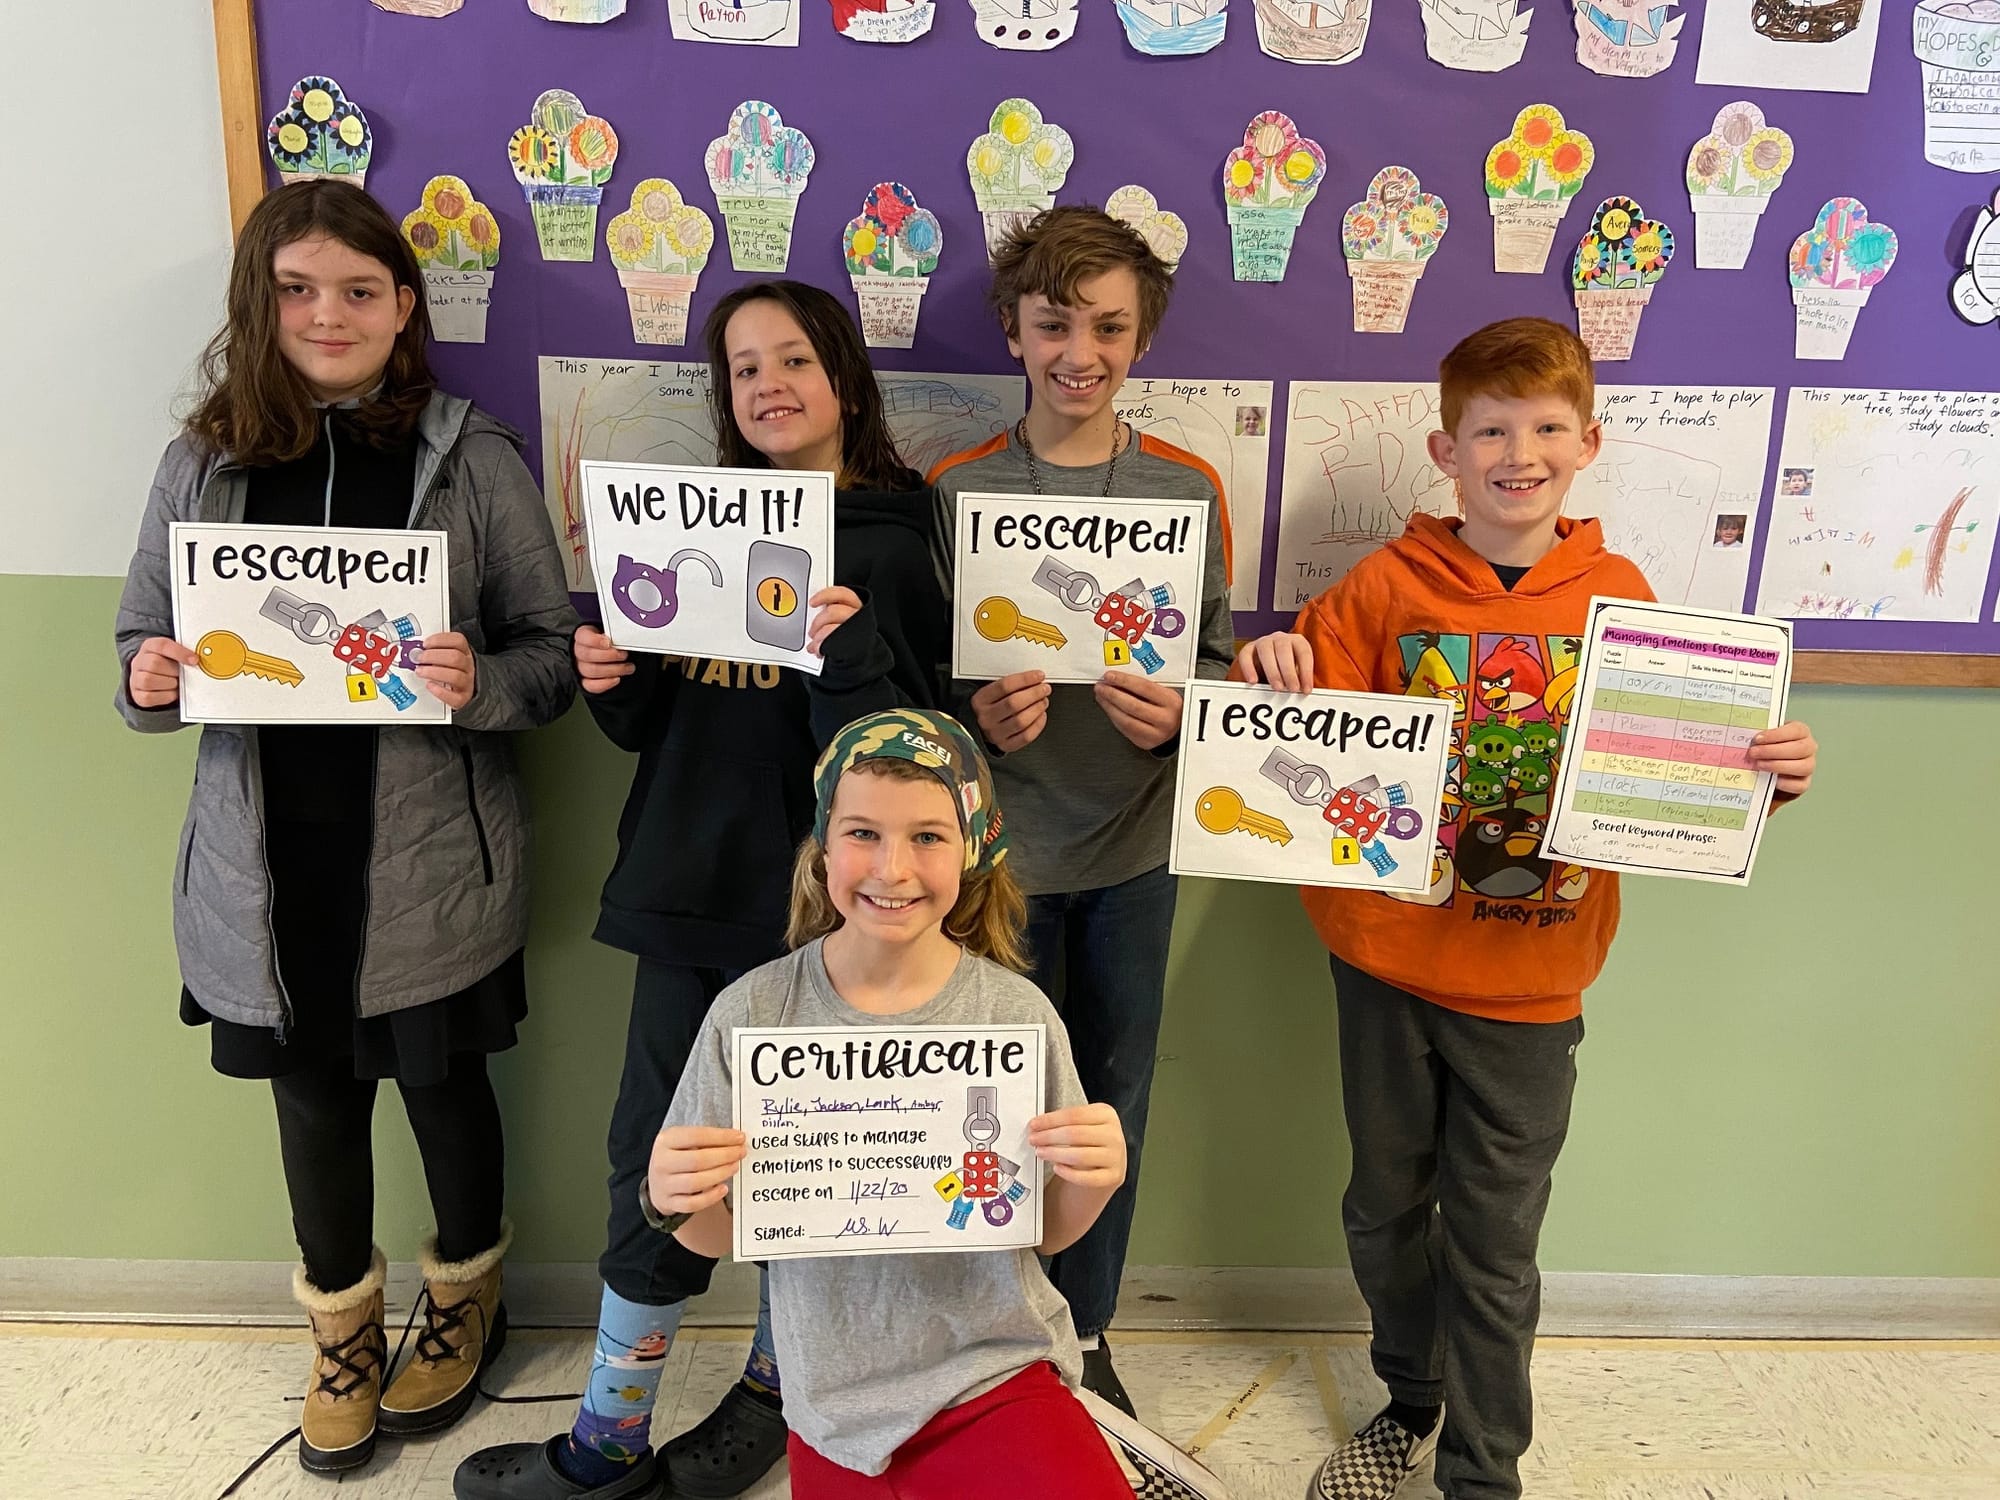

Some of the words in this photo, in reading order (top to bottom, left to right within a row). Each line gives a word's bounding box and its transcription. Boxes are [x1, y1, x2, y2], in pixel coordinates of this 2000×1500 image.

[699, 2, 746, 23] Payton
[1917, 16, 1939, 32] my
[1918, 32, 1977, 51] HOPES
[555, 360, 588, 374] This
[601, 364, 635, 381] year
[648, 365, 661, 377] I
[676, 364, 709, 384] hope
[658, 386, 694, 397] some
[1142, 381, 1155, 393] I
[1171, 381, 1208, 404] hope
[1223, 382, 1241, 397] to
[1605, 394, 1637, 409] year
[1649, 391, 1663, 405] I
[1674, 391, 1703, 409] hope
[1712, 389, 1725, 403] to
[1728, 390, 1764, 409] play
[1802, 390, 1831, 402] This
[1841, 393, 1869, 406] year
[1879, 391, 1891, 402] I
[1899, 391, 1927, 407] hope
[1933, 391, 1947, 403] to
[1953, 392, 1987, 409] plant
[1116, 403, 1157, 421] eeds.
[1593, 411, 1613, 425] ith
[1626, 417, 1648, 433] my
[1658, 409, 1721, 431] friends.
[1864, 403, 1894, 417] tree,
[1900, 404, 1933, 421] study
[1939, 405, 1985, 418] flowers
[1908, 420, 1943, 438] study
[1949, 420, 1995, 438] clouds.
[607, 482, 666, 526] We
[678, 482, 747, 530] Did
[760, 487, 804, 535] It!
[970, 511, 982, 554] I
[994, 513, 1191, 558] escaped!
[185, 541, 198, 586] I
[212, 543, 430, 590] escaped!
[1295, 562, 1332, 579] This
[1295, 589, 1310, 605] be
[1605, 629, 1660, 649] Managing
[1661, 636, 1708, 652] Emotions
[1712, 643, 1747, 657] Escape
[1749, 648, 1776, 660] Room
[1196, 699, 1211, 742] I
[1222, 703, 1434, 753] escaped!
[1592, 819, 1627, 834] Secret
[1676, 830, 1717, 844] Phrase:
[751, 1039, 1024, 1087] Certificate
[761, 1096, 807, 1120] Rylie,
[844, 1132, 858, 1145] to
[863, 1129, 927, 1146] manage
[752, 1157, 823, 1175] emotions
[829, 1158, 843, 1172] to
[848, 1154, 953, 1171] successfully
[752, 1186, 810, 1203] escape
[815, 1185, 833, 1201] on
[850, 1177, 908, 1206] 1/22/20
